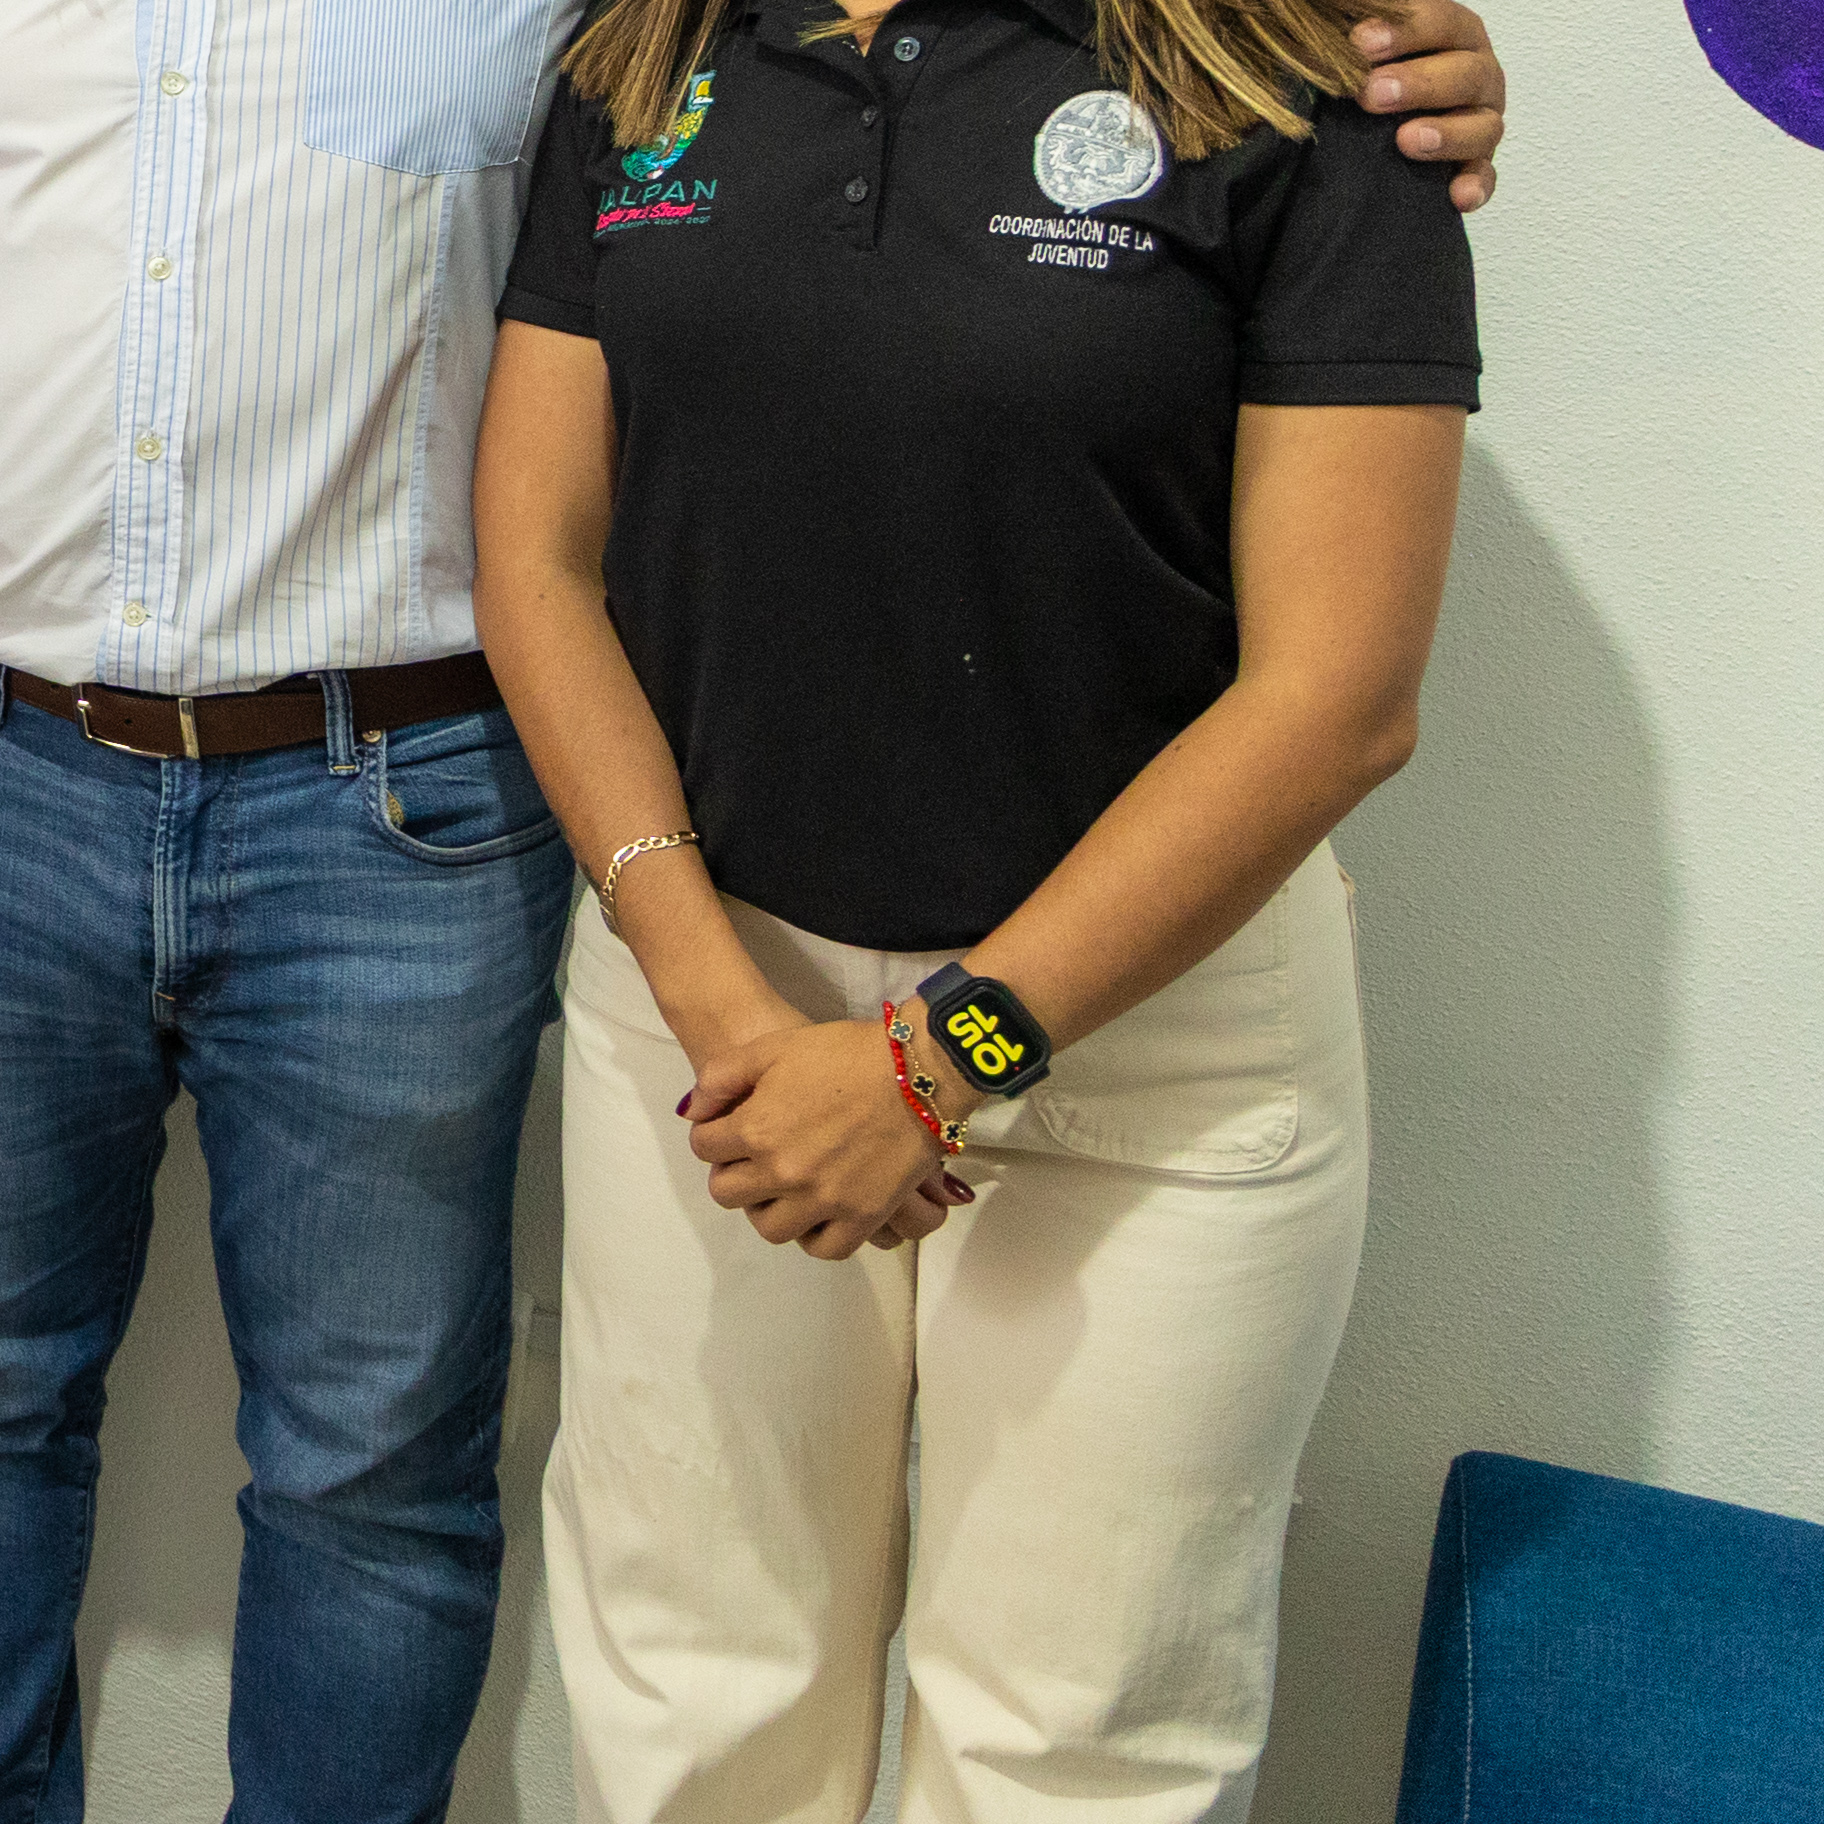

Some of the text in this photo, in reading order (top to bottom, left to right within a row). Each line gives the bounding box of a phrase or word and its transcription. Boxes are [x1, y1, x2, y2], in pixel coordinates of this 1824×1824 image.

[989, 215, 1153, 251] COORDINACIÓN DE LA
[1028, 243, 1109, 269] JUVENTUD
[947, 1004, 998, 1048] 15
[972, 1033, 1024, 1075] 10
